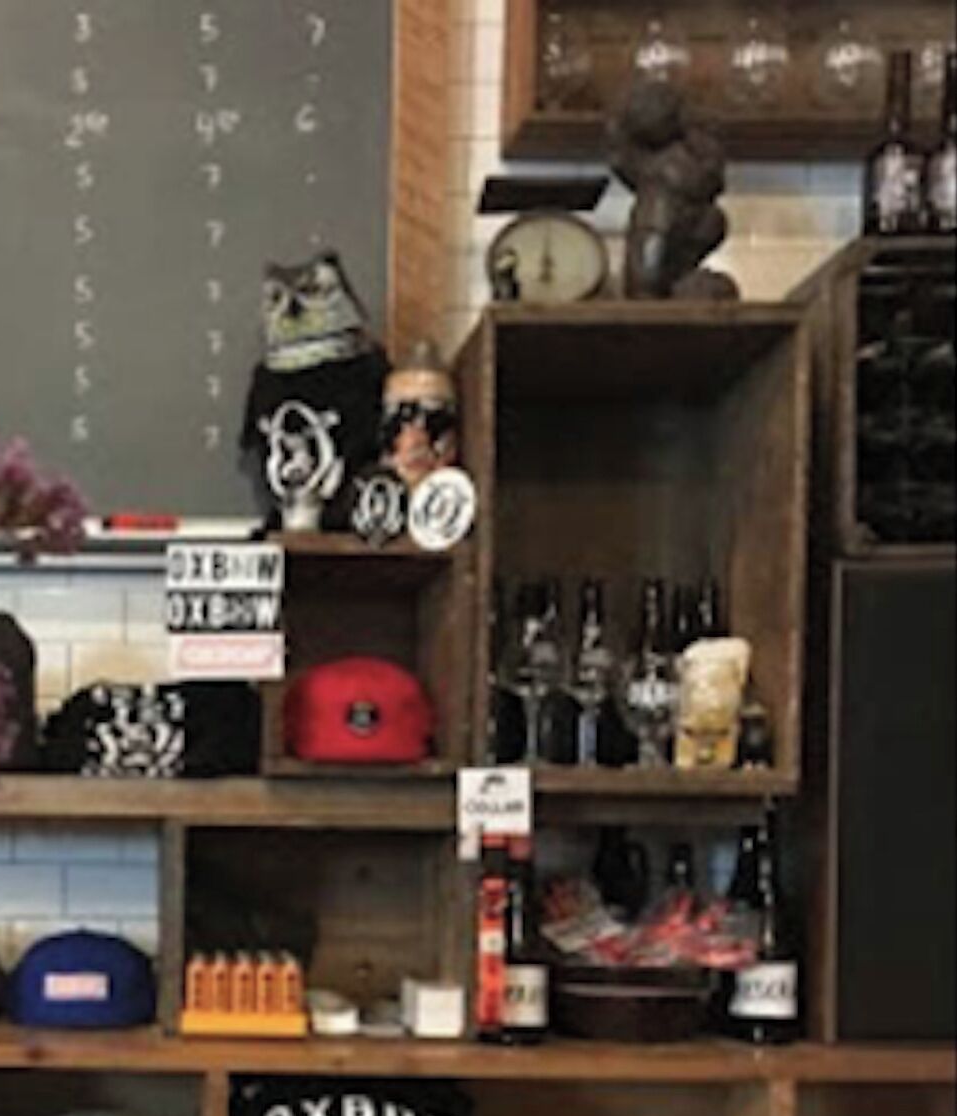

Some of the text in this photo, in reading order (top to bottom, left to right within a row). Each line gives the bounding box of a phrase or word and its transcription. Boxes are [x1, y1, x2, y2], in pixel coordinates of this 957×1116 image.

[199, 12, 219, 43] 5
[168, 550, 280, 582] OXBW
[167, 593, 280, 627] OXBW
